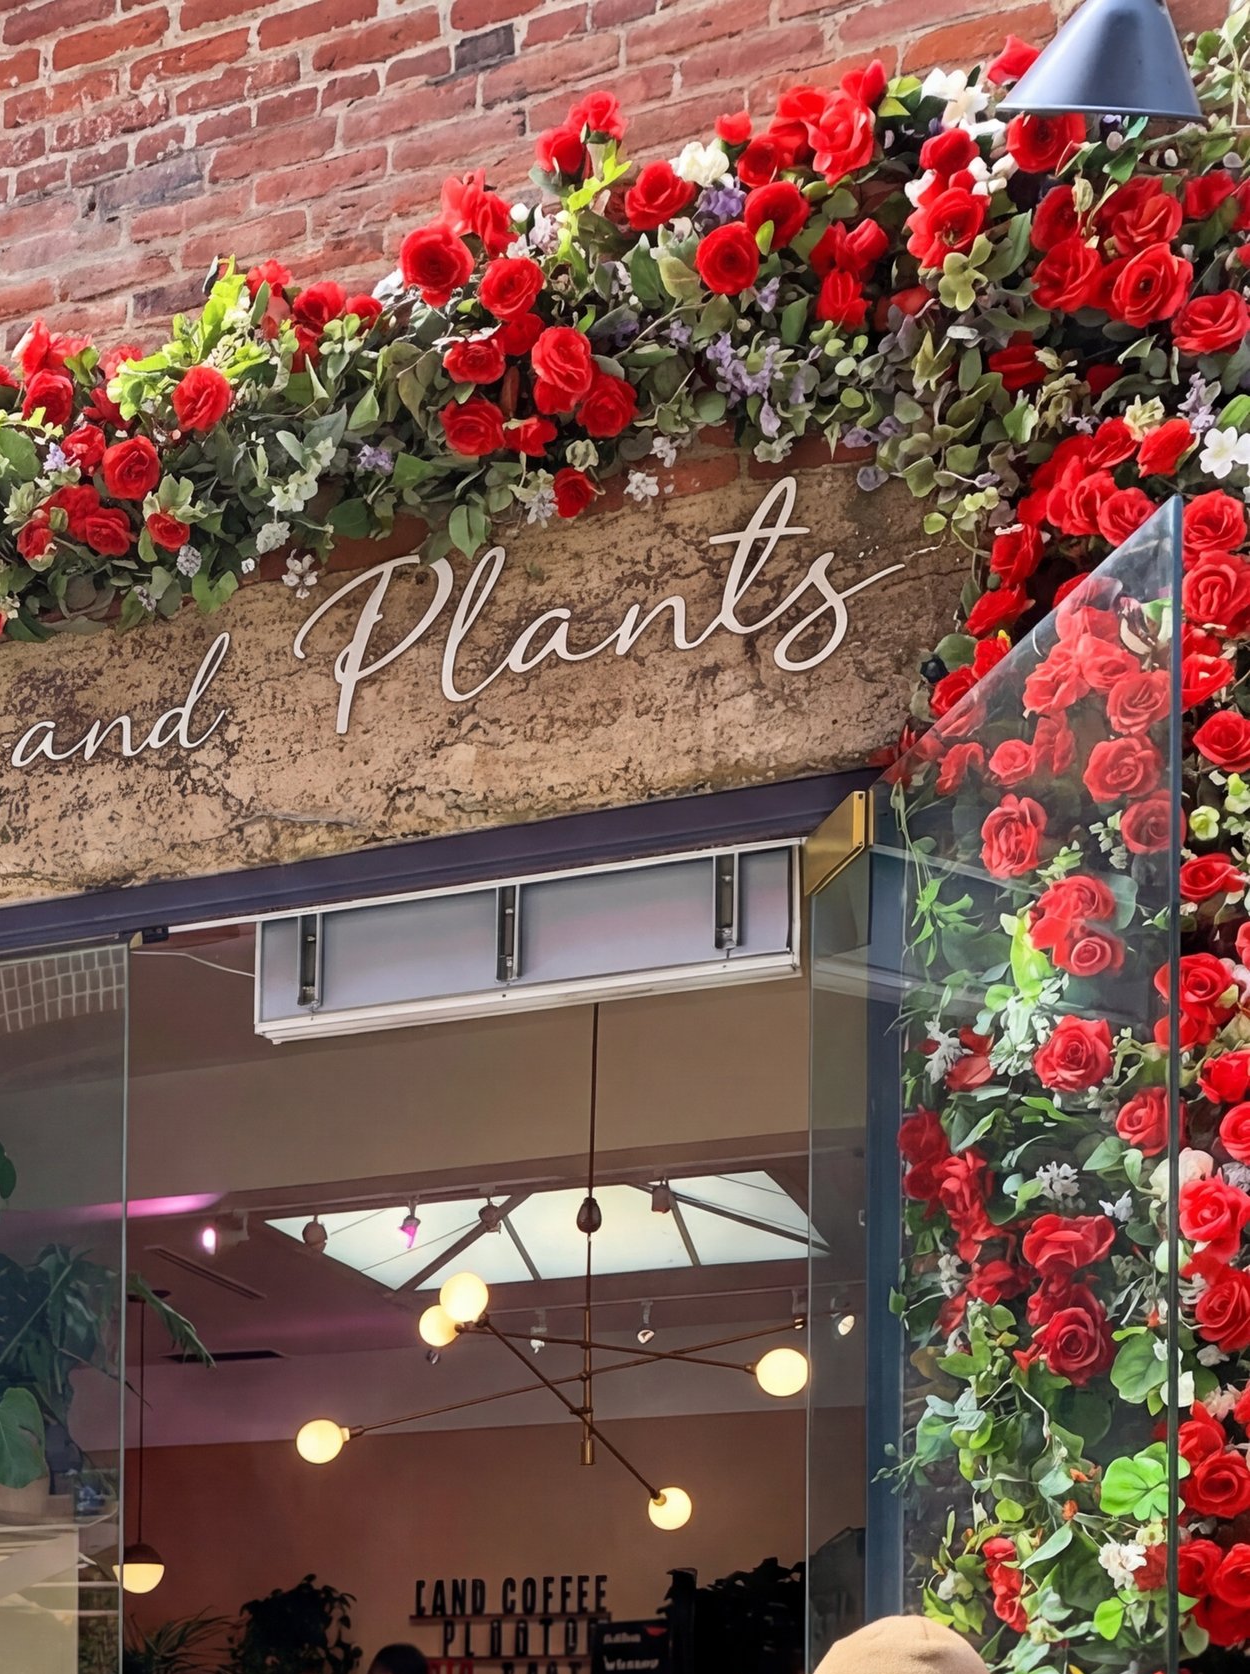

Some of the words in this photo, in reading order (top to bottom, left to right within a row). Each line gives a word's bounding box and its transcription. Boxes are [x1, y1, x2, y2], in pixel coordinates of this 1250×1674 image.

[11, 632, 229, 767] and
[293, 476, 906, 734] Plants
[502, 1575, 608, 1615] COFFEE
